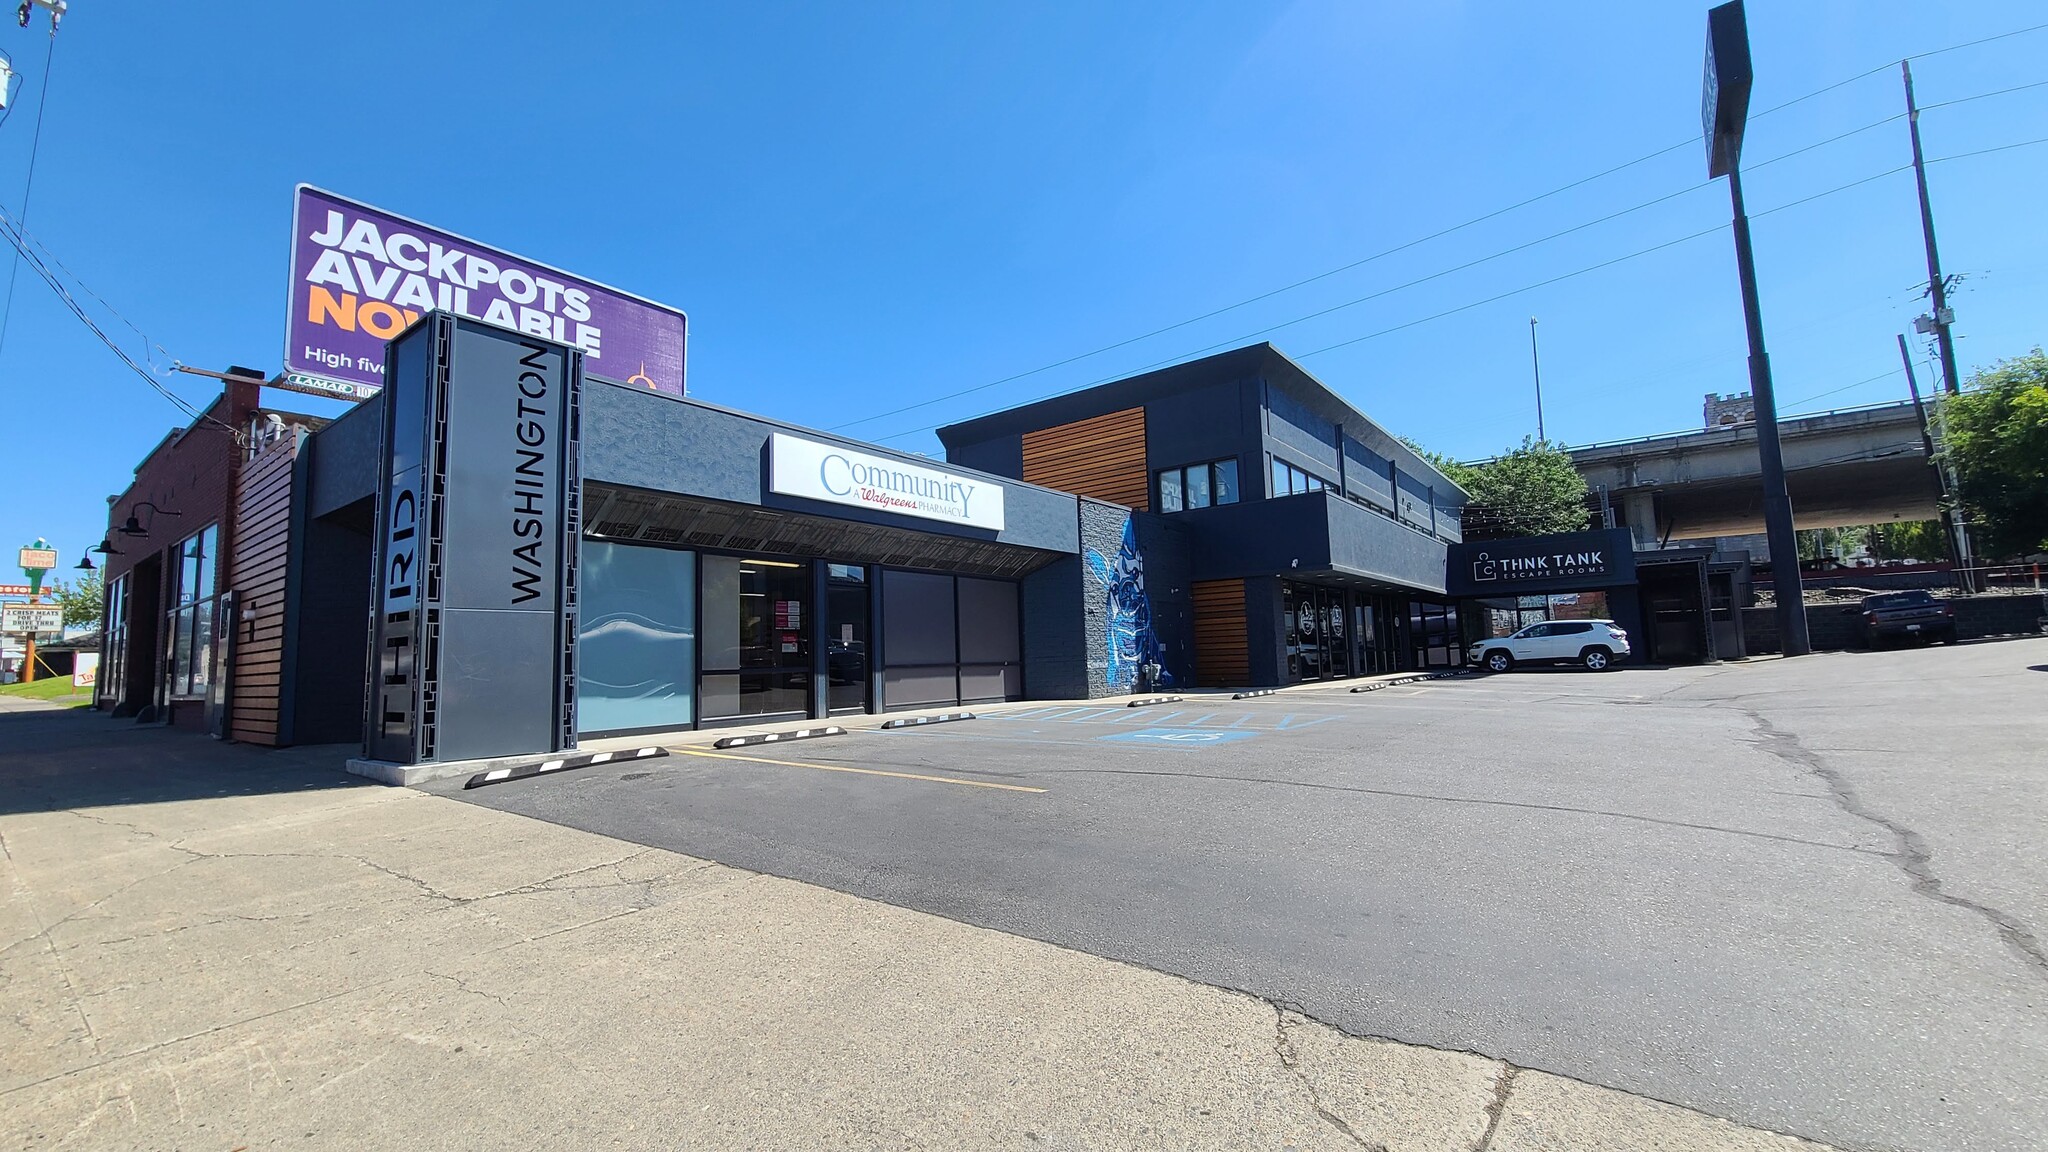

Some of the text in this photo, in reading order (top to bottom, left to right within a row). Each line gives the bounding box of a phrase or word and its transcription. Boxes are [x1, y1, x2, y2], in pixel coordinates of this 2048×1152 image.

[309, 209, 592, 322] JACKPOTS
[305, 249, 601, 360] AVAILABLE
[305, 345, 352, 369] High
[295, 375, 346, 392] LAMAR
[511, 340, 549, 605] WASHINGTON
[852, 487, 963, 518] A Walgreens PHARMACY
[1503, 566, 1605, 580] ESCAPE ROOMS
[1553, 551, 1603, 567] TANK
[381, 489, 416, 739] THIRD
